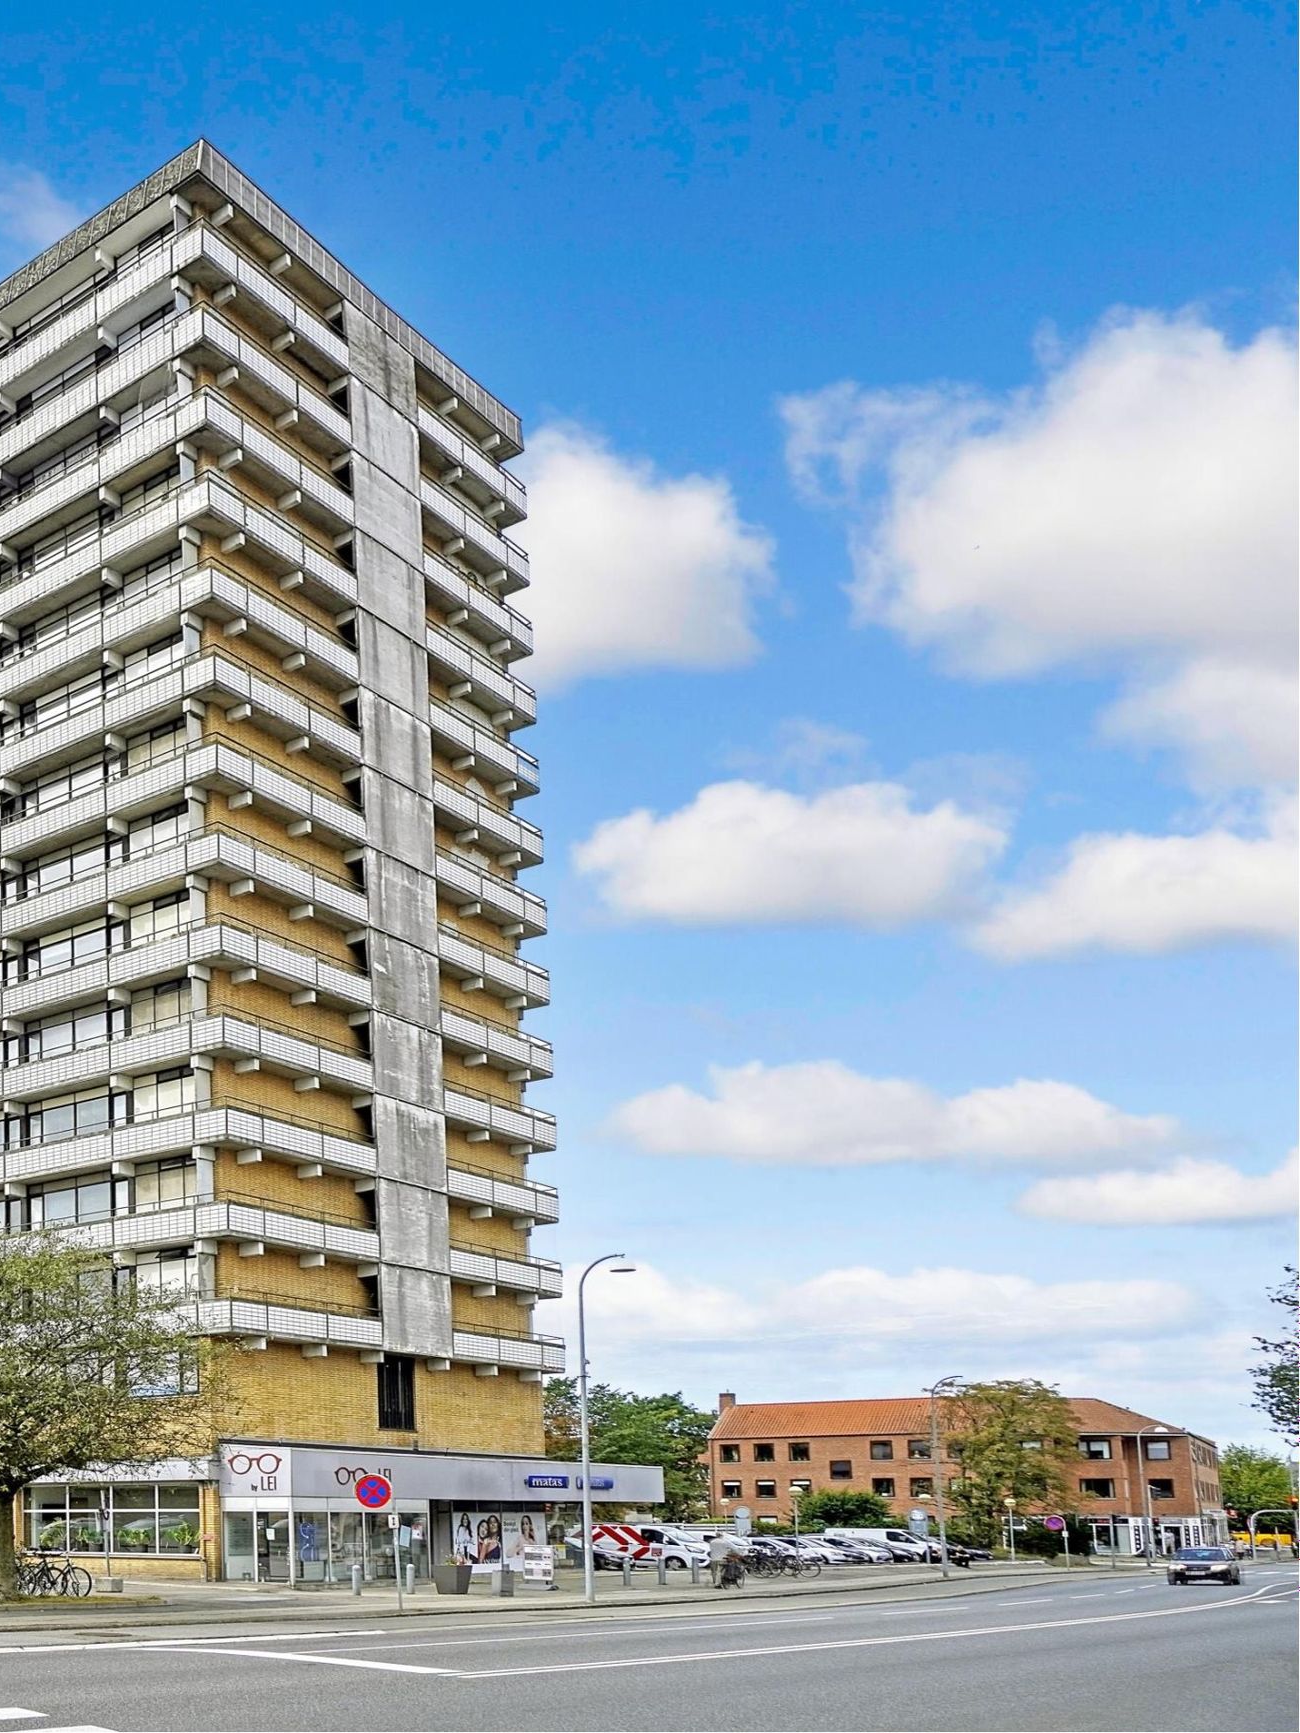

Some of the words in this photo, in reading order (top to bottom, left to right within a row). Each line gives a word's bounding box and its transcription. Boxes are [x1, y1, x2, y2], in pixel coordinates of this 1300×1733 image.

[251, 1483, 258, 1492] by
[261, 1475, 277, 1491] LEI
[532, 1477, 563, 1487] matas
